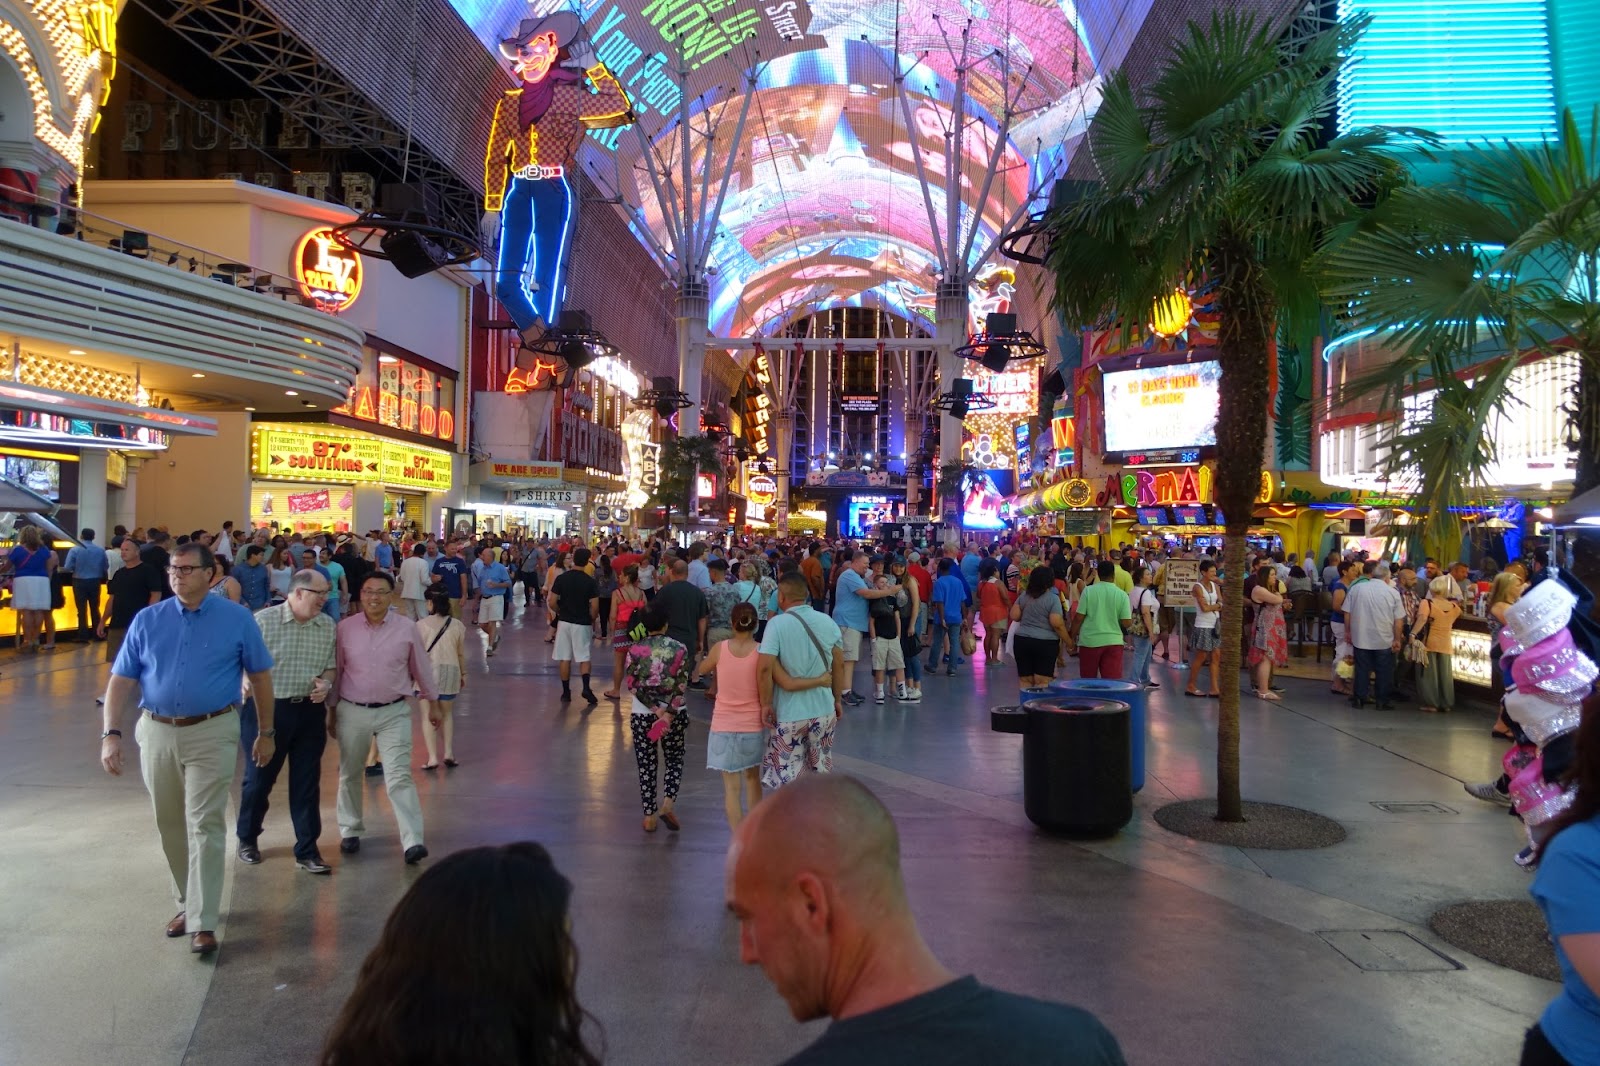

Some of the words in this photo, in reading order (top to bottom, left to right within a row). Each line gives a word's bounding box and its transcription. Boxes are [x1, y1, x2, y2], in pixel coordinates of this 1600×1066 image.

[590, 4, 643, 77] YOUR
[305, 270, 355, 294] TATTO
[288, 454, 364, 473] SOUVENIRS
[495, 464, 508, 473] WE
[510, 465, 527, 474] ARE
[643, 447, 655, 485] ABC
[513, 490, 572, 501] T-SHIRTS
[1096, 465, 1211, 507] MERMAI
